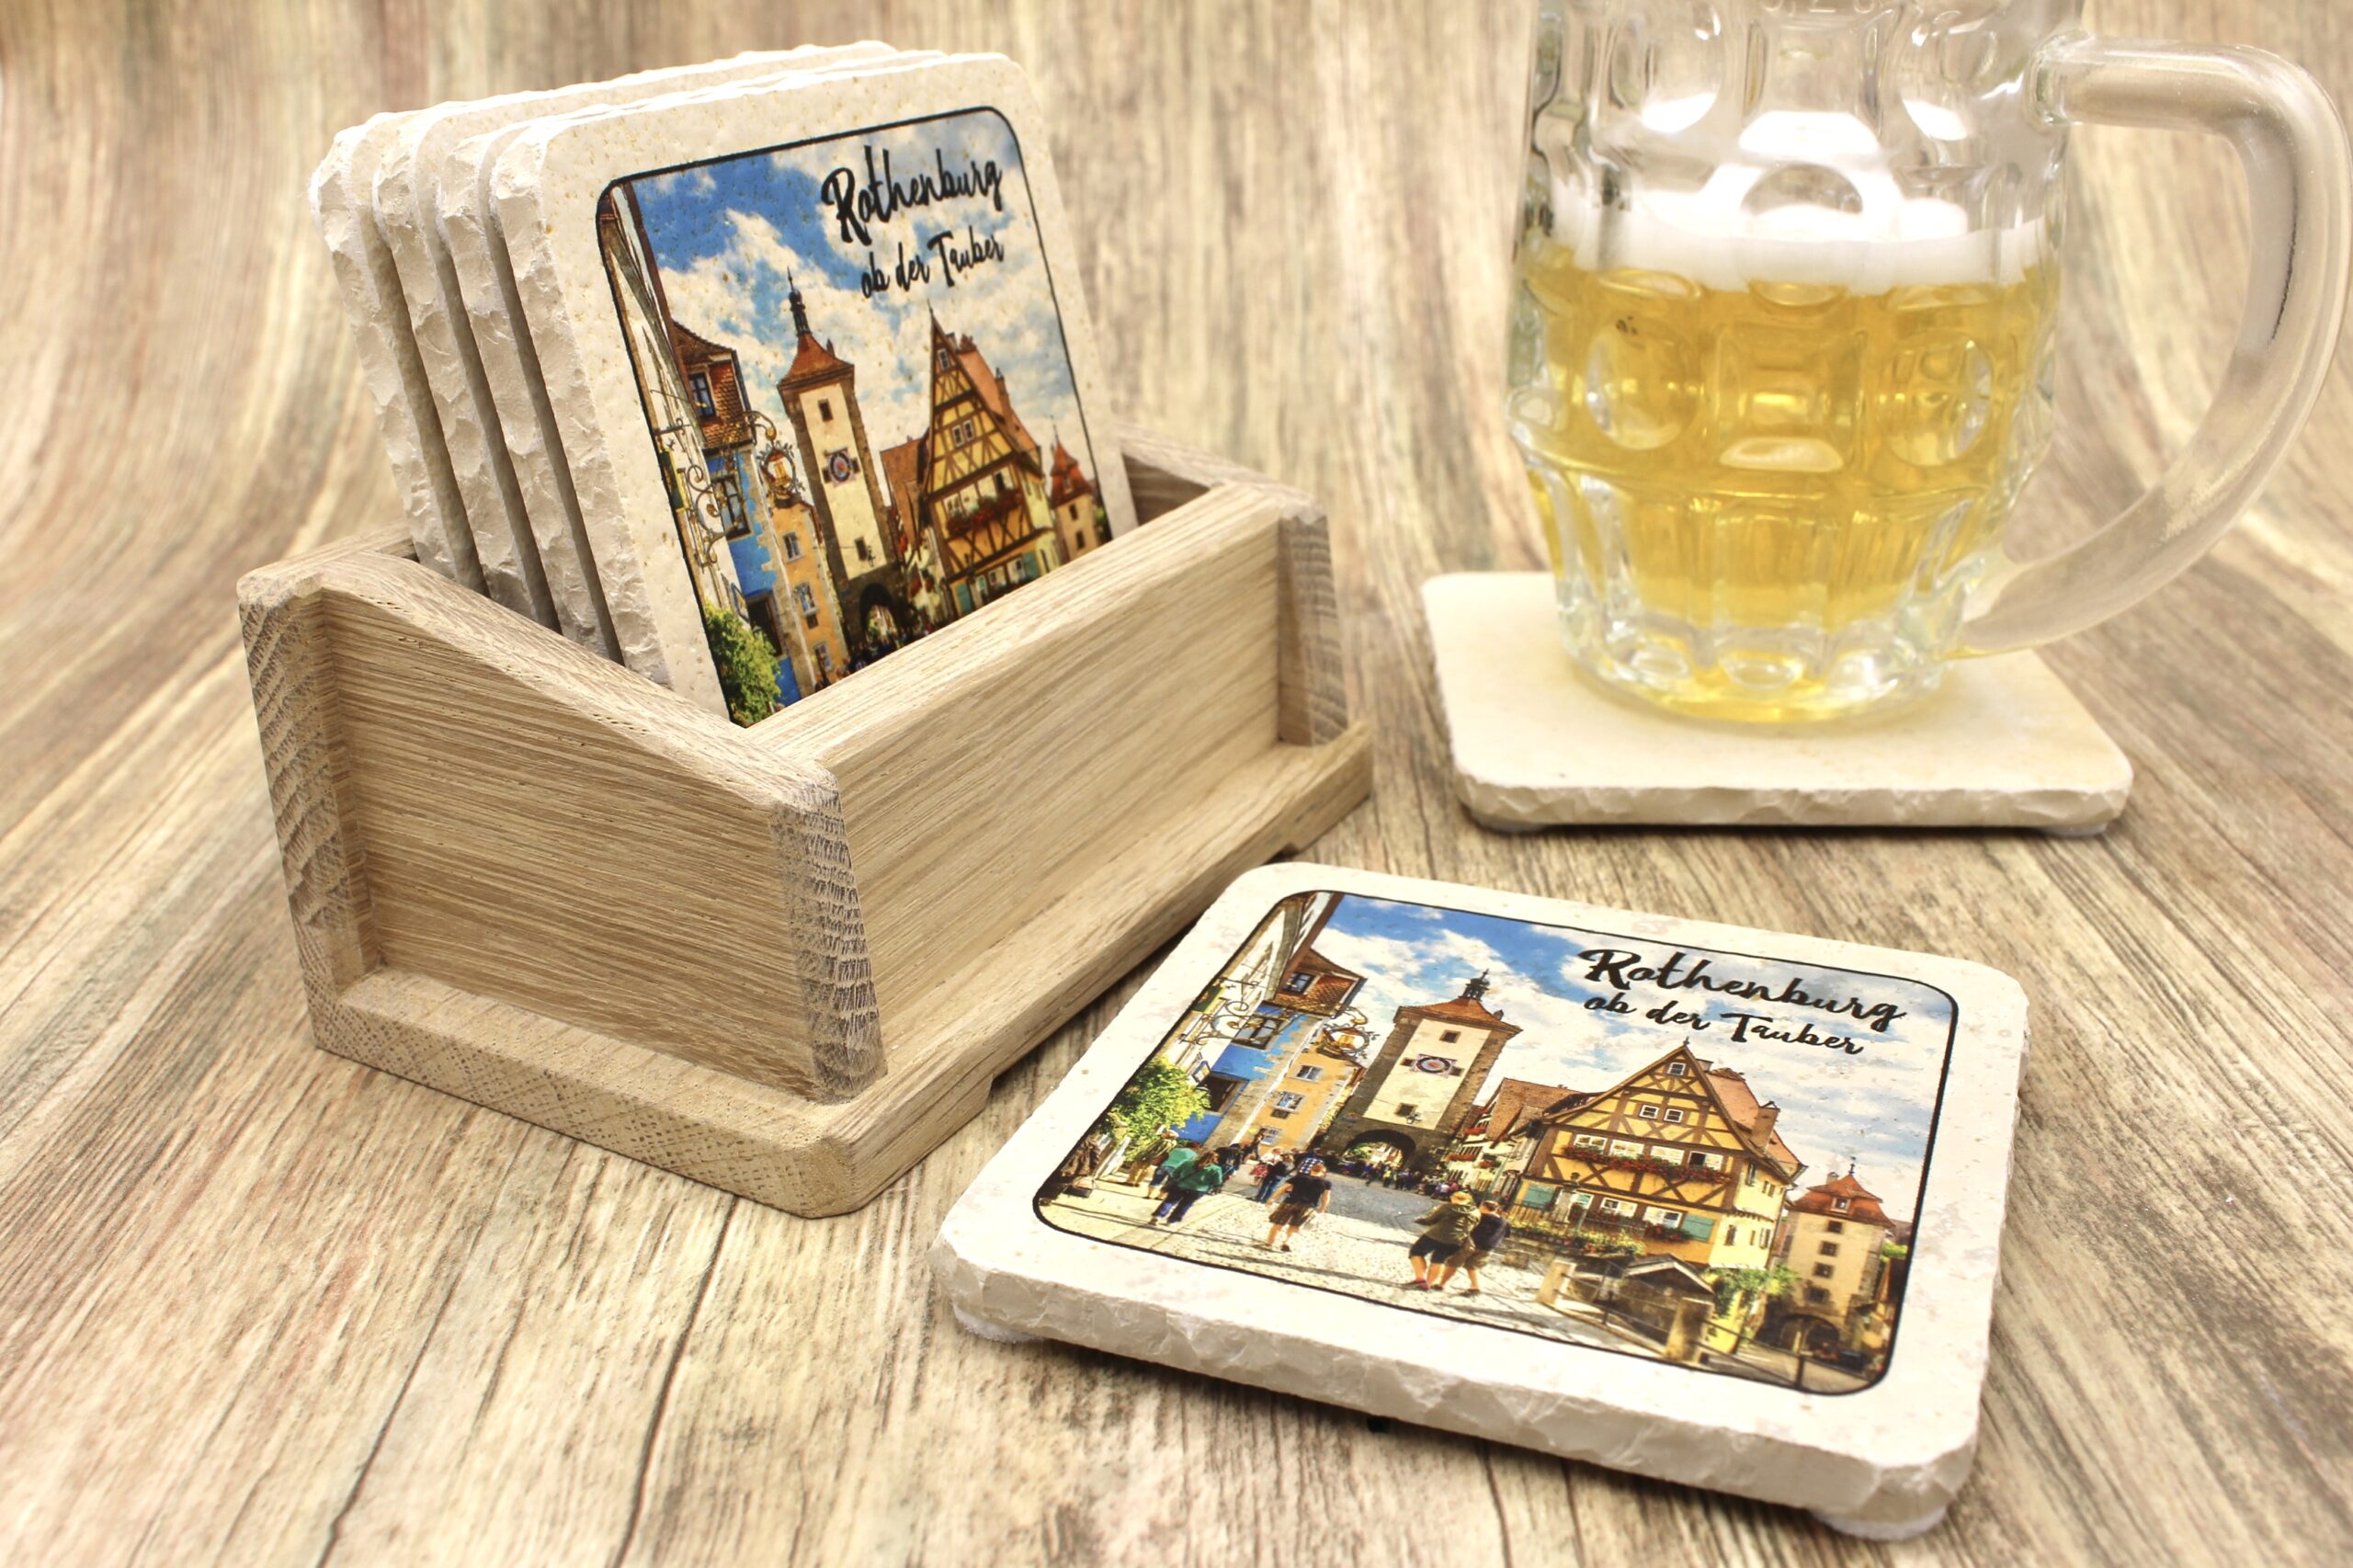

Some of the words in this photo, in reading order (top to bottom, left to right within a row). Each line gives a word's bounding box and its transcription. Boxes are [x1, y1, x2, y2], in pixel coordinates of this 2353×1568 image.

[822, 145, 1003, 246] Rothenburg
[861, 251, 890, 299] ob
[896, 242, 929, 292] der
[927, 225, 1004, 288] Tauber
[1578, 949, 1907, 1032] Rothenburg
[1584, 992, 1637, 1014] ob
[1645, 1000, 1711, 1030] der
[1720, 1012, 1864, 1055] Tauber
